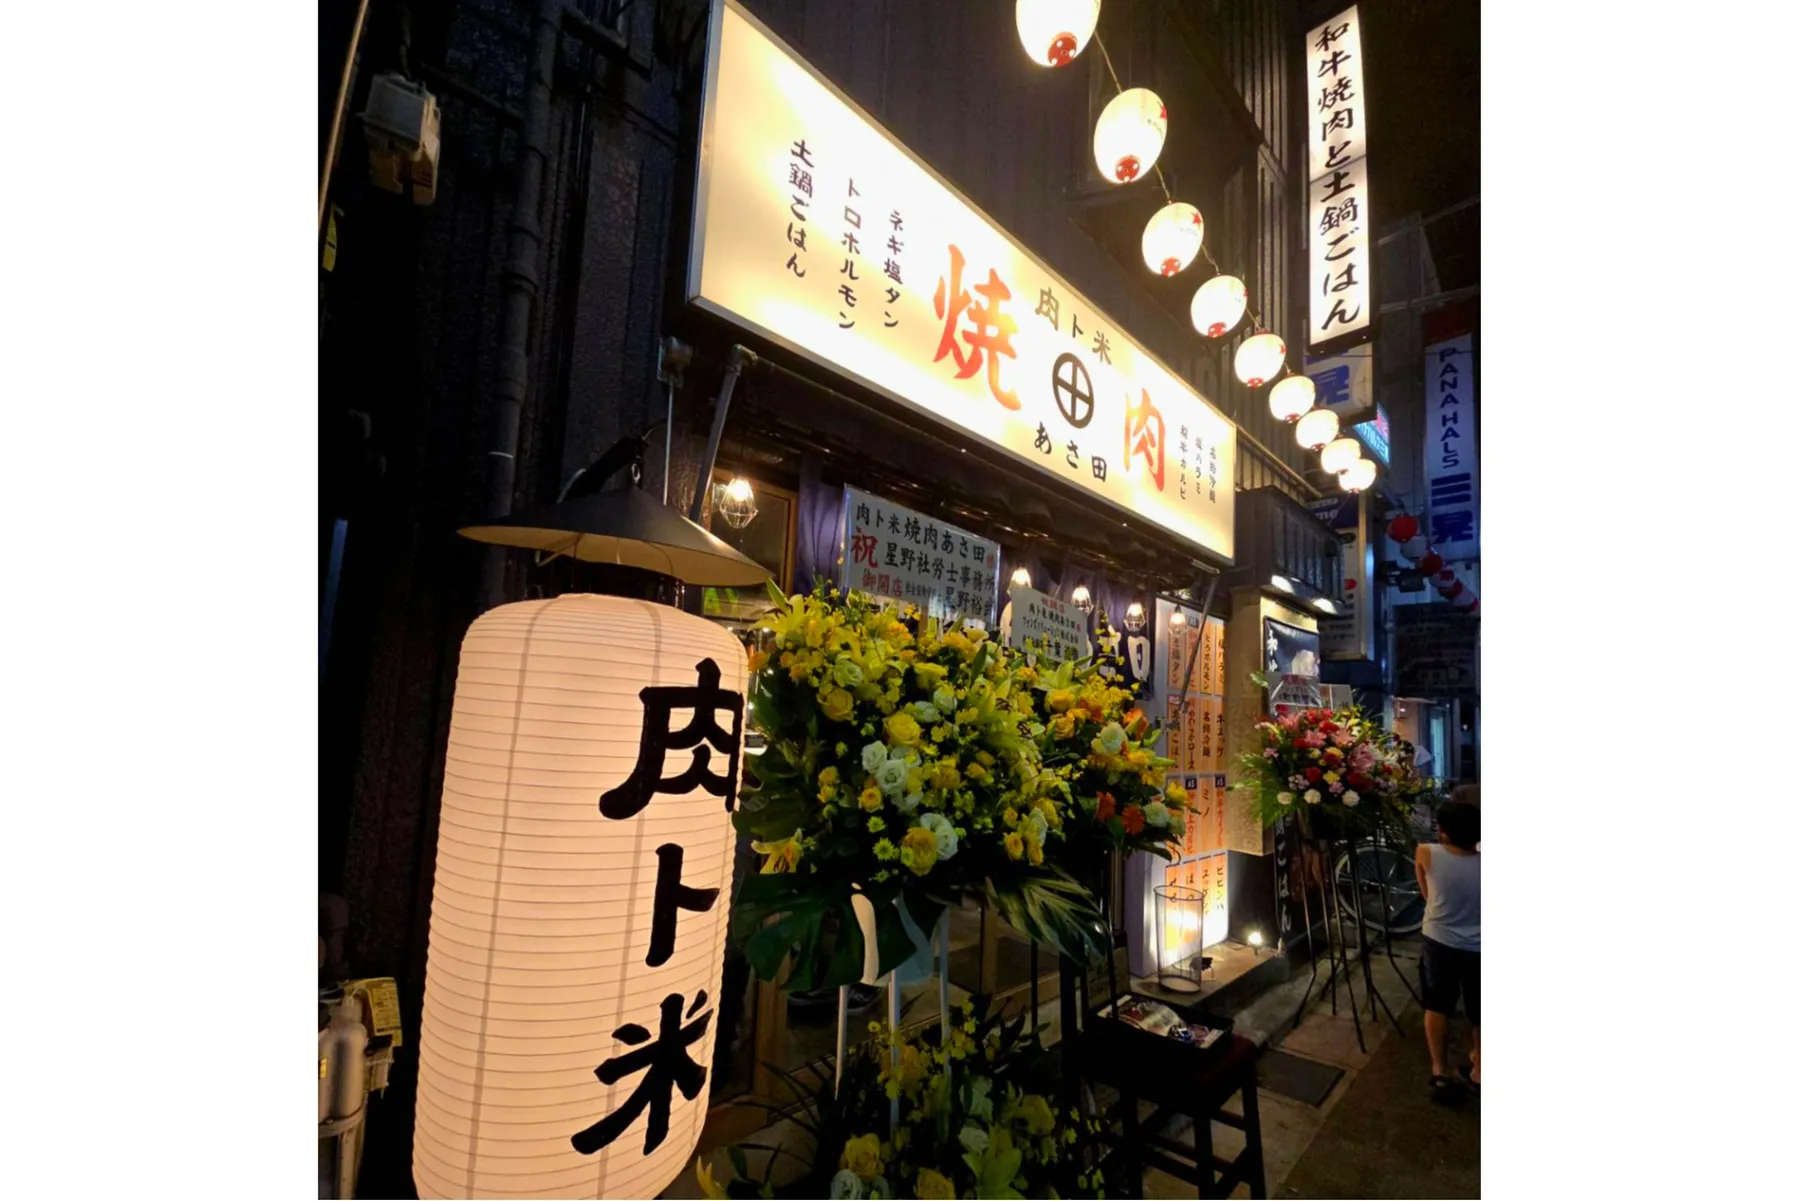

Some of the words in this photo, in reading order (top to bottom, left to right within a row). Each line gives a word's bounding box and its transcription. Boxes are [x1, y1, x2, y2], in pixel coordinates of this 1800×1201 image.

[786, 139, 814, 278] 土鍋ごはん
[1315, 22, 1360, 331] 和牛焼肉と土鍋ごはん
[838, 178, 862, 329] トロホルモン
[884, 210, 904, 328] ネギ塩タン
[933, 244, 1022, 411] 焼
[1124, 387, 1165, 492] 肉
[1035, 287, 1112, 365] 肉ト米
[1034, 421, 1107, 482] あさ田
[851, 526, 878, 568] 祝
[862, 568, 903, 597] 御開店
[571, 657, 744, 1156] 肉ト米
